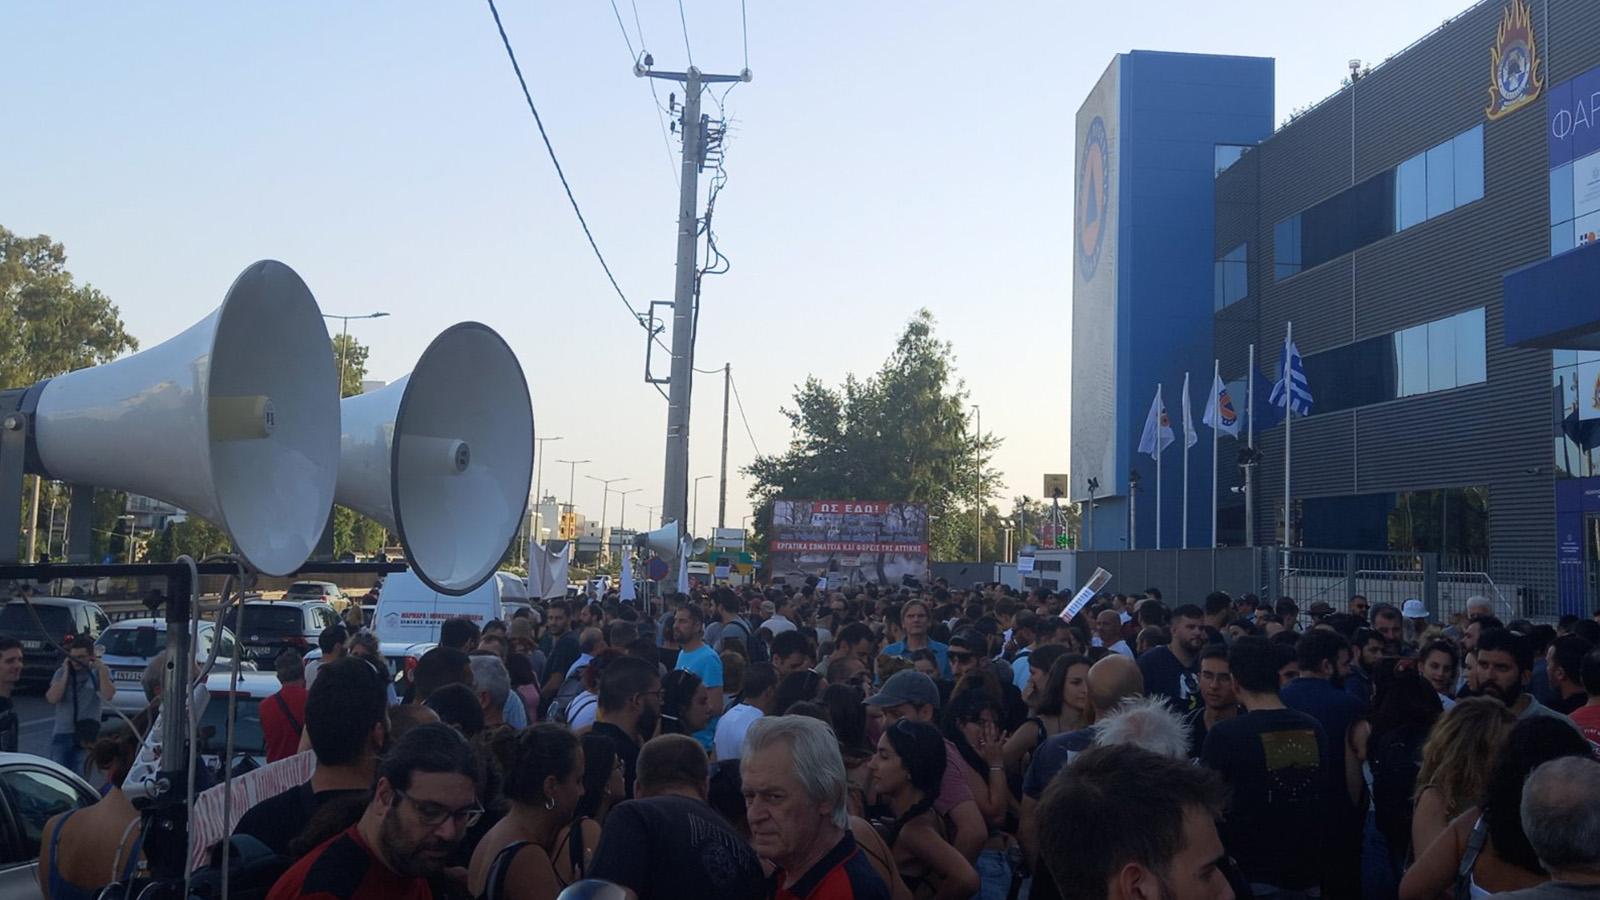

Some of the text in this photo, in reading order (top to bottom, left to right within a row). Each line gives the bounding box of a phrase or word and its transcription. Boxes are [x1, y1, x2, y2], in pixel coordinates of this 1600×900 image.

[821, 504, 879, 513] ΩΣ ΕΔΩ!
[777, 542, 921, 552] ΕΡΓΑΤΙΚΑ ΣΩΜΑΤΕΙΑ ΚΑΙ ΦΟΡΕΙΣ ΤΗΣ ΑΤΤΙΚΗΣ
